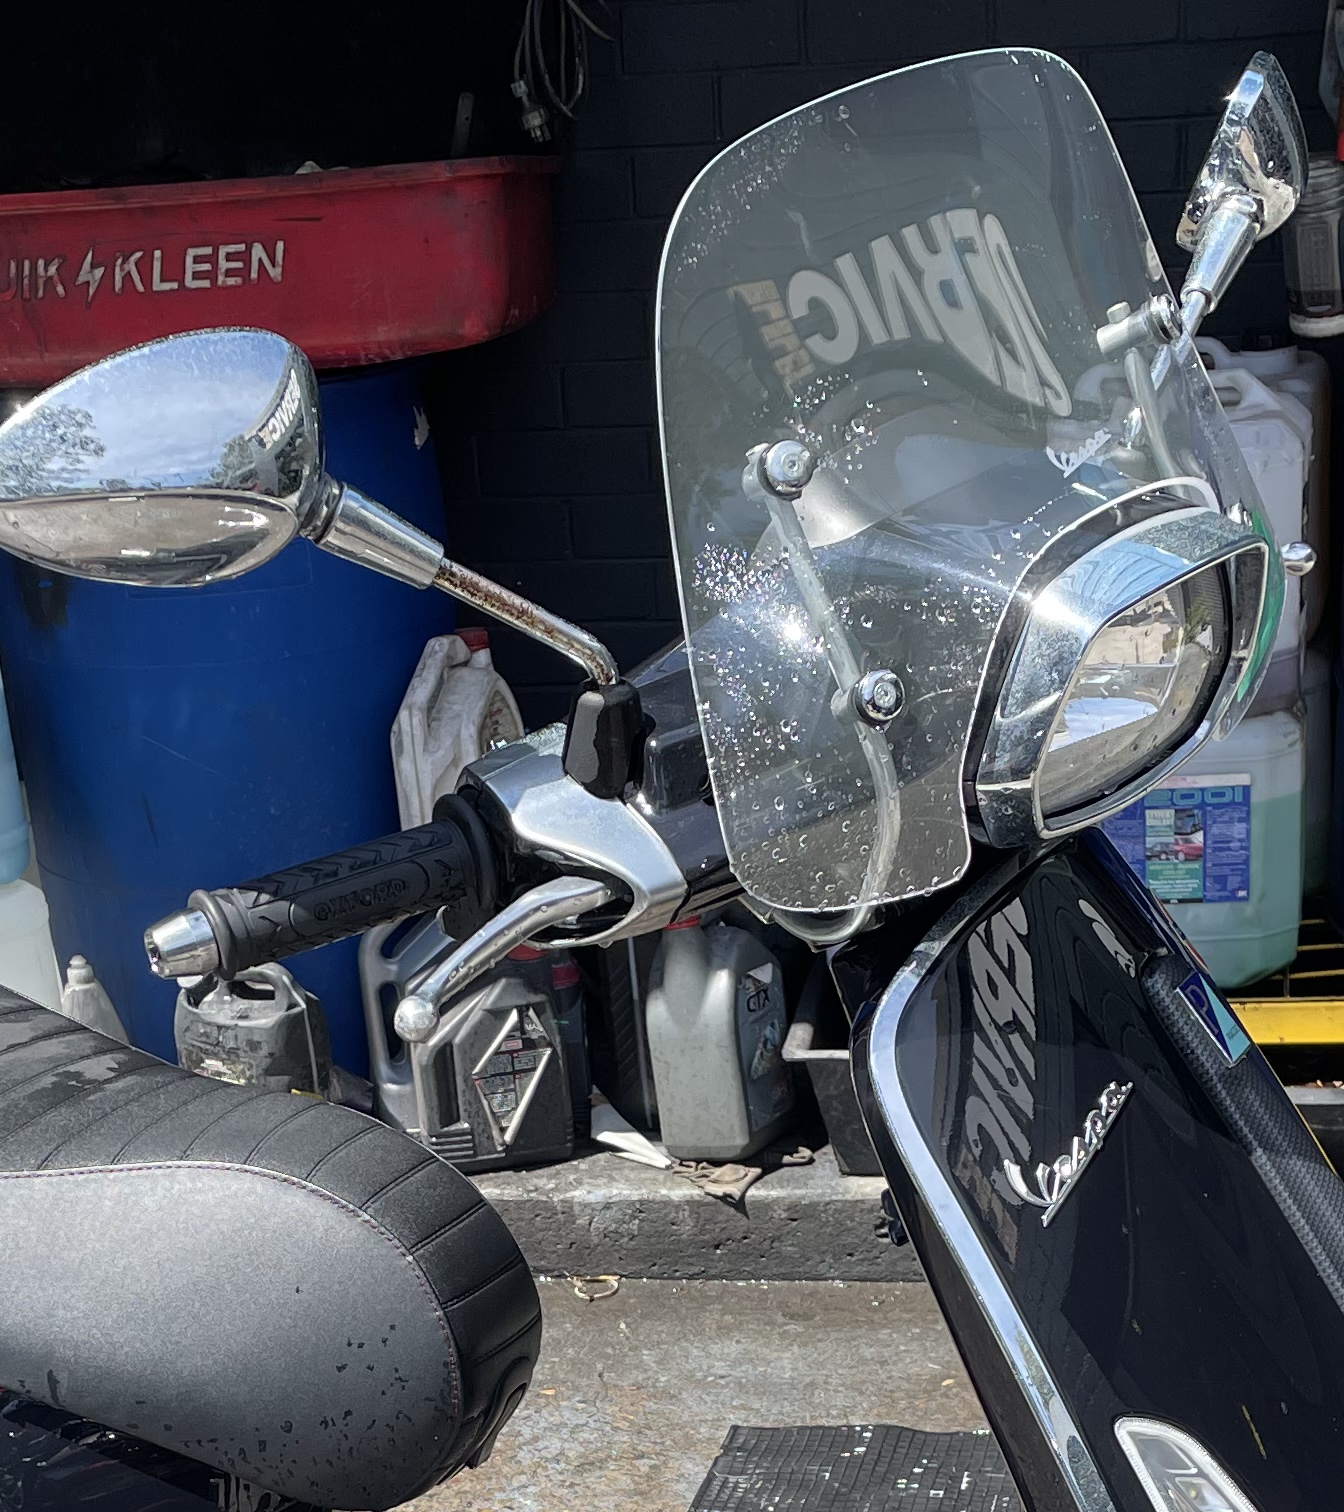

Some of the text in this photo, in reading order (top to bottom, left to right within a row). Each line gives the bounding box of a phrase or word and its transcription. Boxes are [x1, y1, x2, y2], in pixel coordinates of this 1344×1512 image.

[114, 240, 285, 295] KLEEN
[1045, 427, 1112, 479] Vespa
[1003, 1080, 1134, 1228] Vespa
